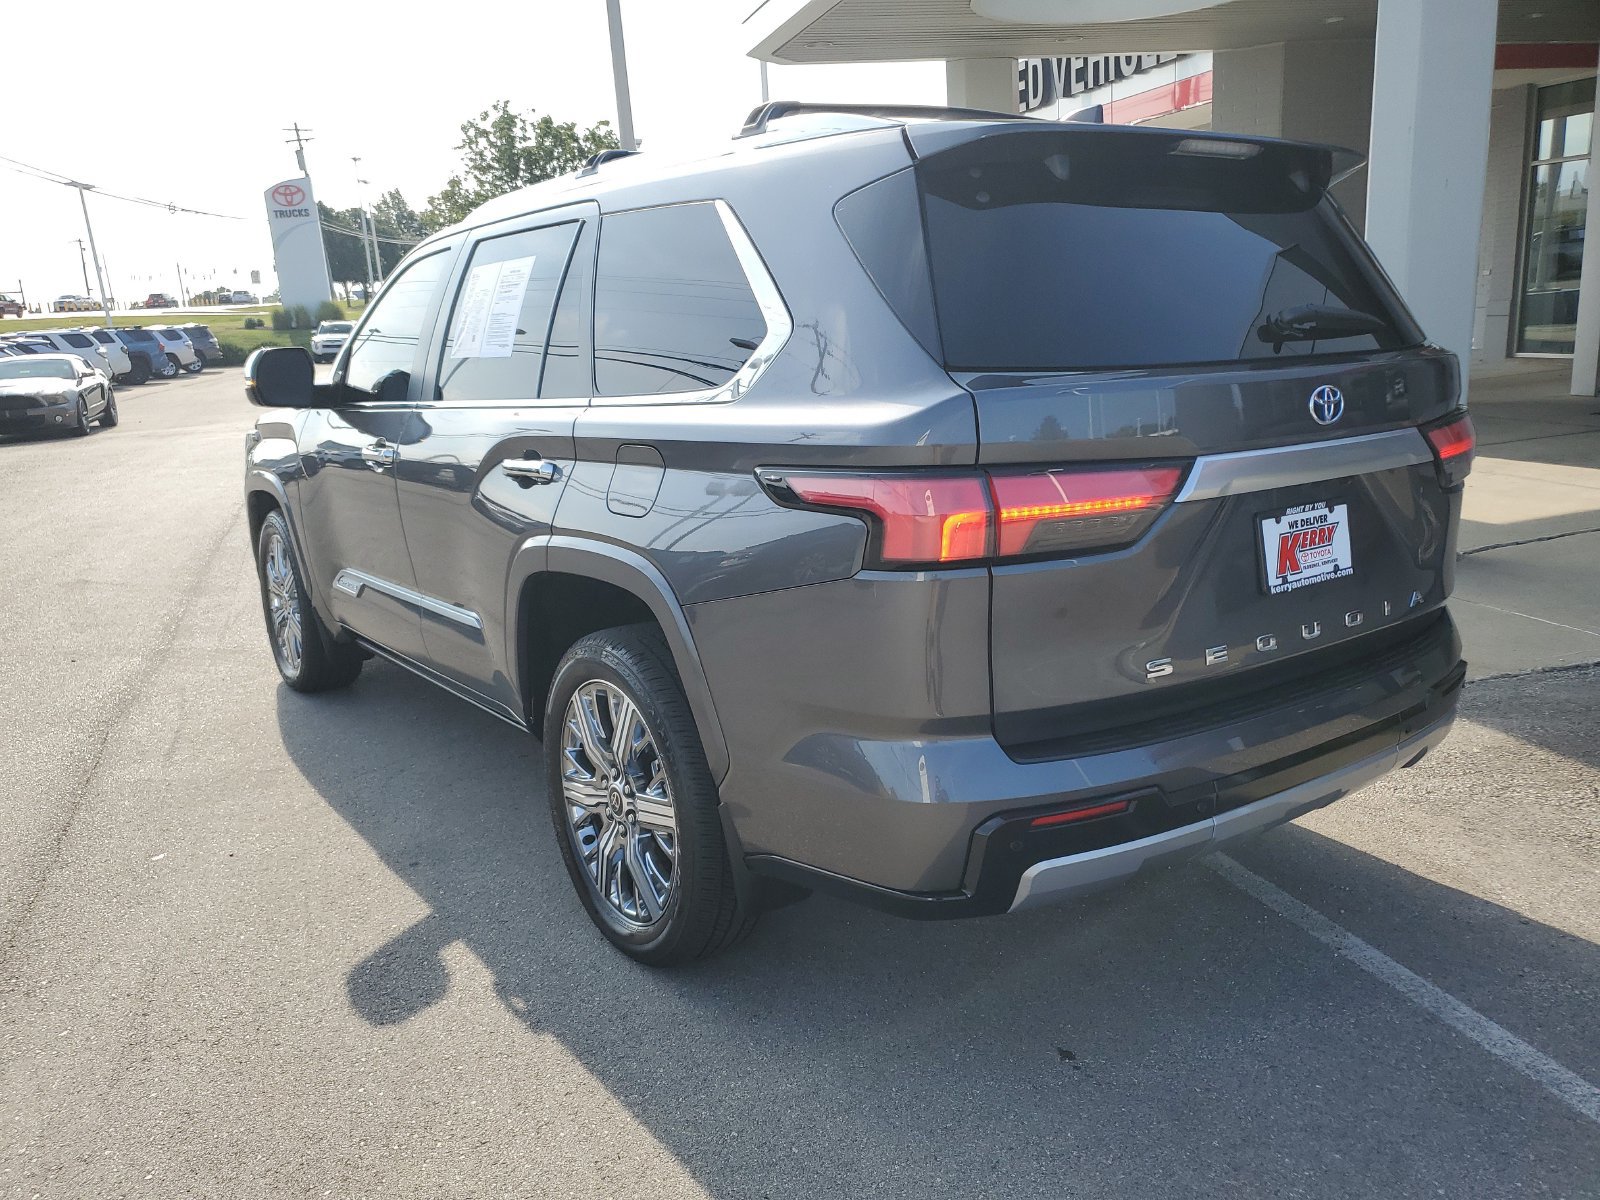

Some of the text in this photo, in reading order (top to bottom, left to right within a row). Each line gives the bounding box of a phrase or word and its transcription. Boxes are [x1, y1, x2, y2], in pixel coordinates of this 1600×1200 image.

[1051, 52, 1177, 99] VEHI
[273, 208, 310, 218] TRUCKS
[1286, 506, 1304, 515] RIGHT
[1314, 501, 1327, 509] YOU
[1288, 514, 1328, 530] WE DELIVER
[1277, 523, 1338, 577] KERRY
[1309, 548, 1331, 559] TOYOTA
[1270, 567, 1354, 594] kerryautomotive.com
[1145, 590, 1425, 679] SEQUOIA
